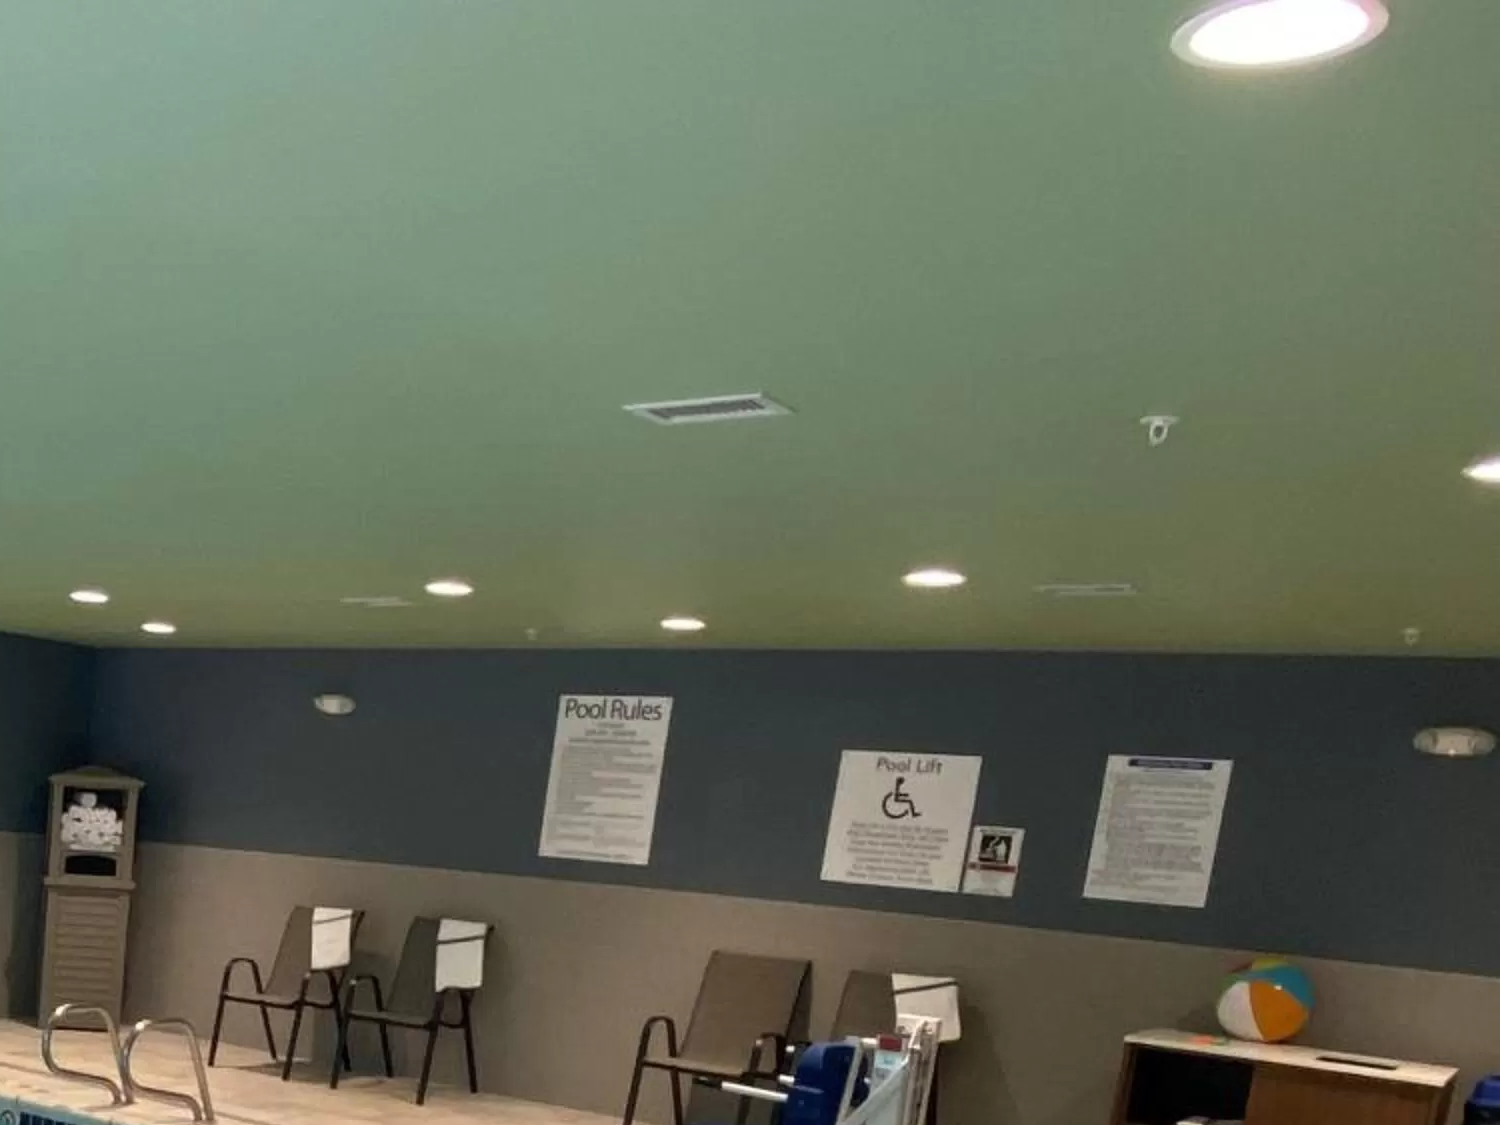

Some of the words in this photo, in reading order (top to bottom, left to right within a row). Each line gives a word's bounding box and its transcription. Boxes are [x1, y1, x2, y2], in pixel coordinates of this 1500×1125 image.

[565, 696, 607, 719] Pool
[610, 697, 663, 721] Rules
[876, 756, 911, 773] Pool
[916, 758, 943, 775] Lift
